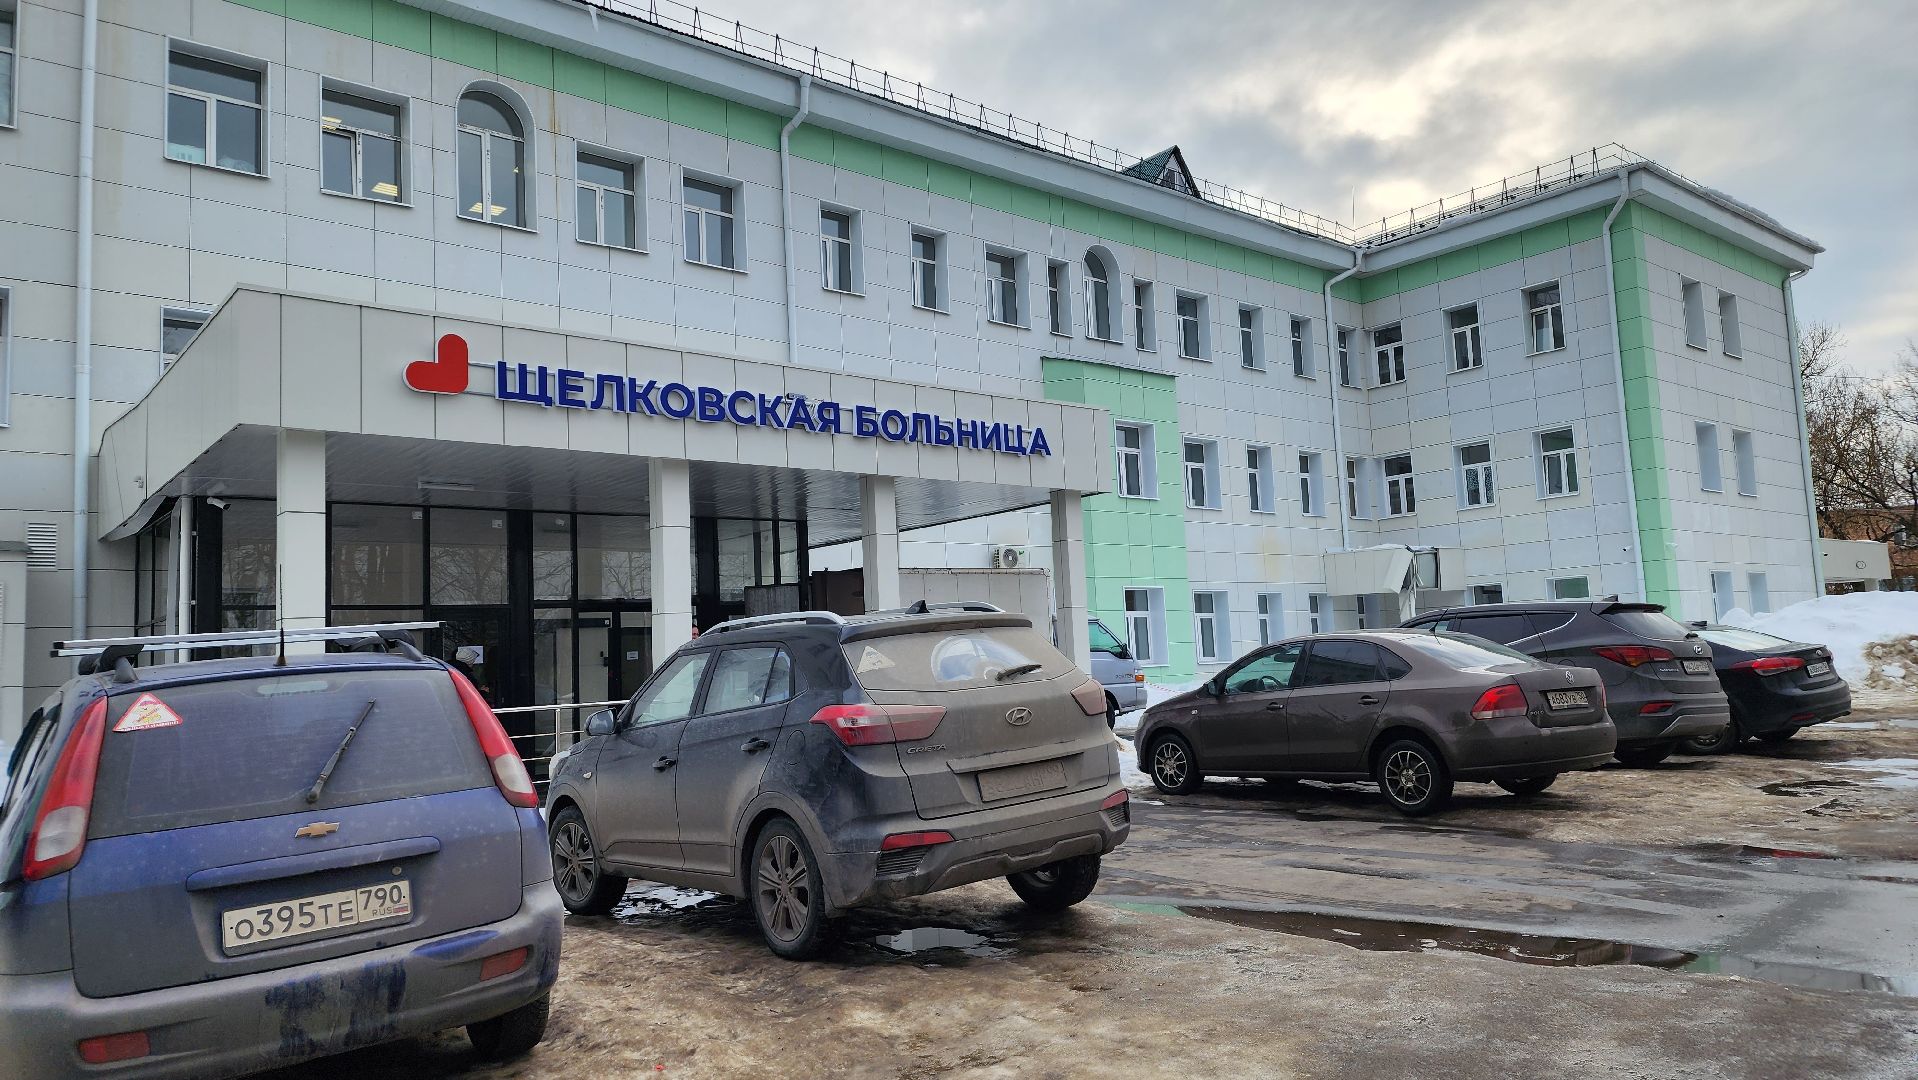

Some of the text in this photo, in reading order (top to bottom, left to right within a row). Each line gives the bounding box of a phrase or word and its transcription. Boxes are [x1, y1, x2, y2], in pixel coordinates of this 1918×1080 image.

[496, 361, 1052, 456] ЩЕЛКОВСКАЯ БОЛЬНИЦА
[907, 743, 947, 754] CRETA
[234, 884, 403, 940] О395ТЕ 790
[372, 907, 393, 917] RUS
